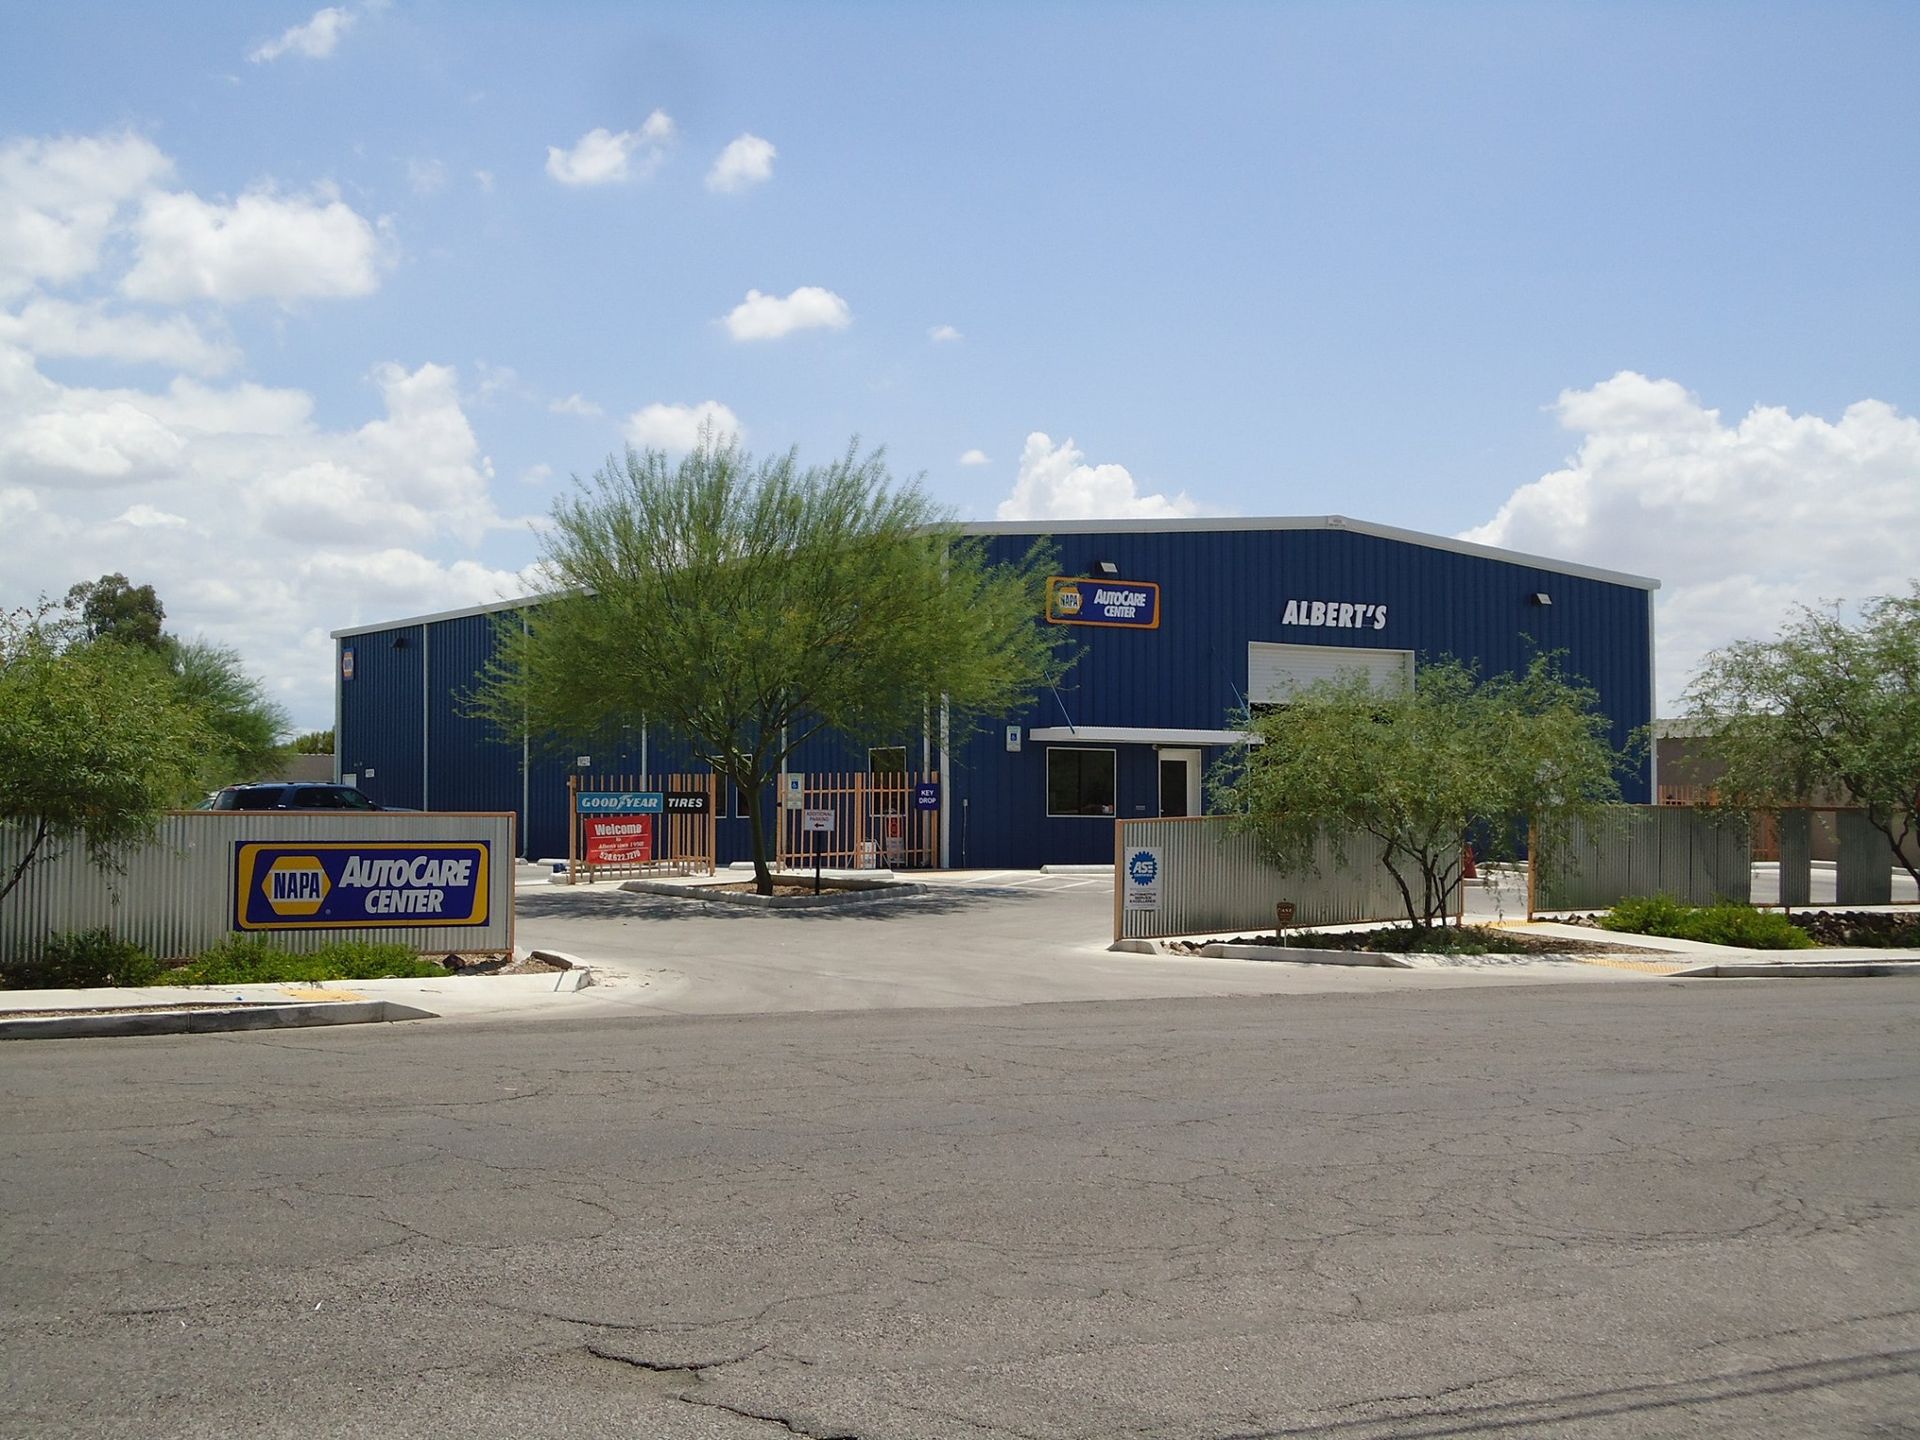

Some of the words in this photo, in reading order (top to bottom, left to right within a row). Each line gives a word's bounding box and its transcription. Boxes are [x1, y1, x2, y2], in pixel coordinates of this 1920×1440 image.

[1104, 606, 1136, 618] CENTER
[1281, 600, 1387, 629] ALBERT'S
[581, 794, 658, 810] GOODYEAR
[668, 798, 703, 808] TIRES
[594, 823, 642, 836] Welcome
[1133, 861, 1153, 873] ASE
[273, 872, 320, 899] NAPA
[364, 889, 444, 914] CENTER
